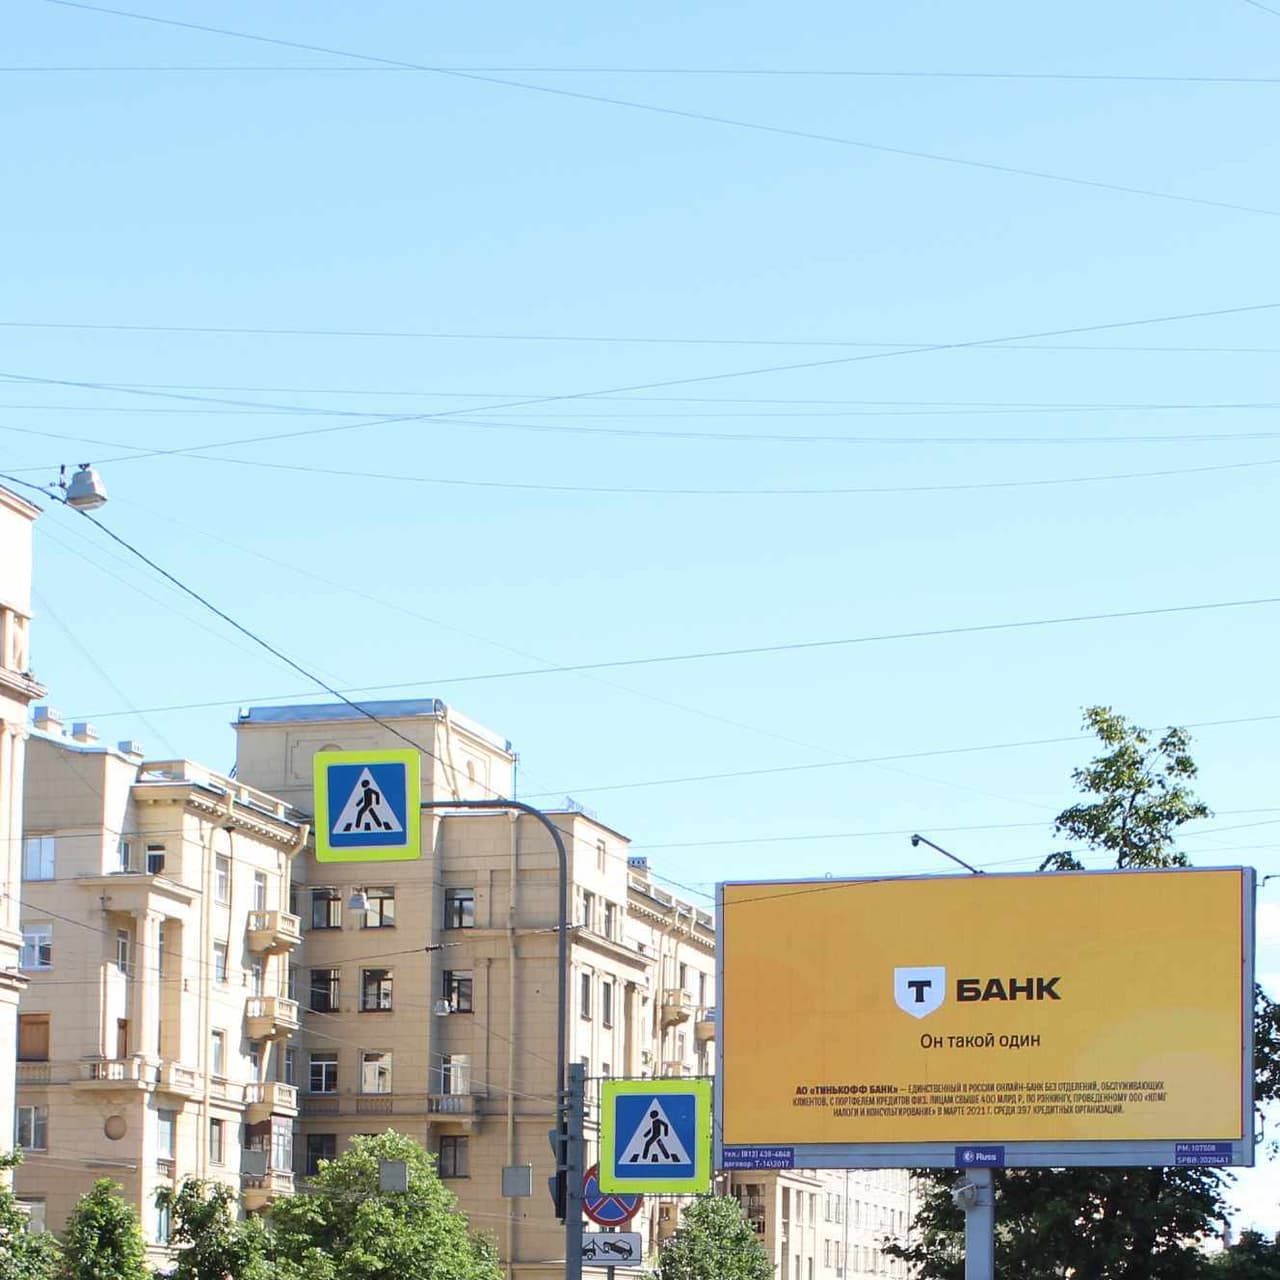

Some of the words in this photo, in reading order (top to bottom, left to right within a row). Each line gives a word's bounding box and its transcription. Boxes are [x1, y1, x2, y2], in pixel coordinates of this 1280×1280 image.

[956, 977, 1062, 1002] БАНК
[920, 1033, 943, 1049] Он
[948, 1032, 995, 1048] такой
[999, 1034, 1041, 1049] один
[795, 1086, 808, 1095] АО
[810, 1085, 867, 1094] «ТИНЬКОФФ
[870, 1084, 898, 1094] БАНК»
[908, 1083, 961, 1094] ЕДИНСТВЕННЫЙ
[968, 1083, 995, 1092] РОССИИ
[1045, 1082, 1057, 1091] БЕЗ
[877, 1095, 910, 1106] КРЕДИТОВ
[943, 1106, 965, 1115] МАРТЕ
[966, 1106, 985, 1115] 2021
